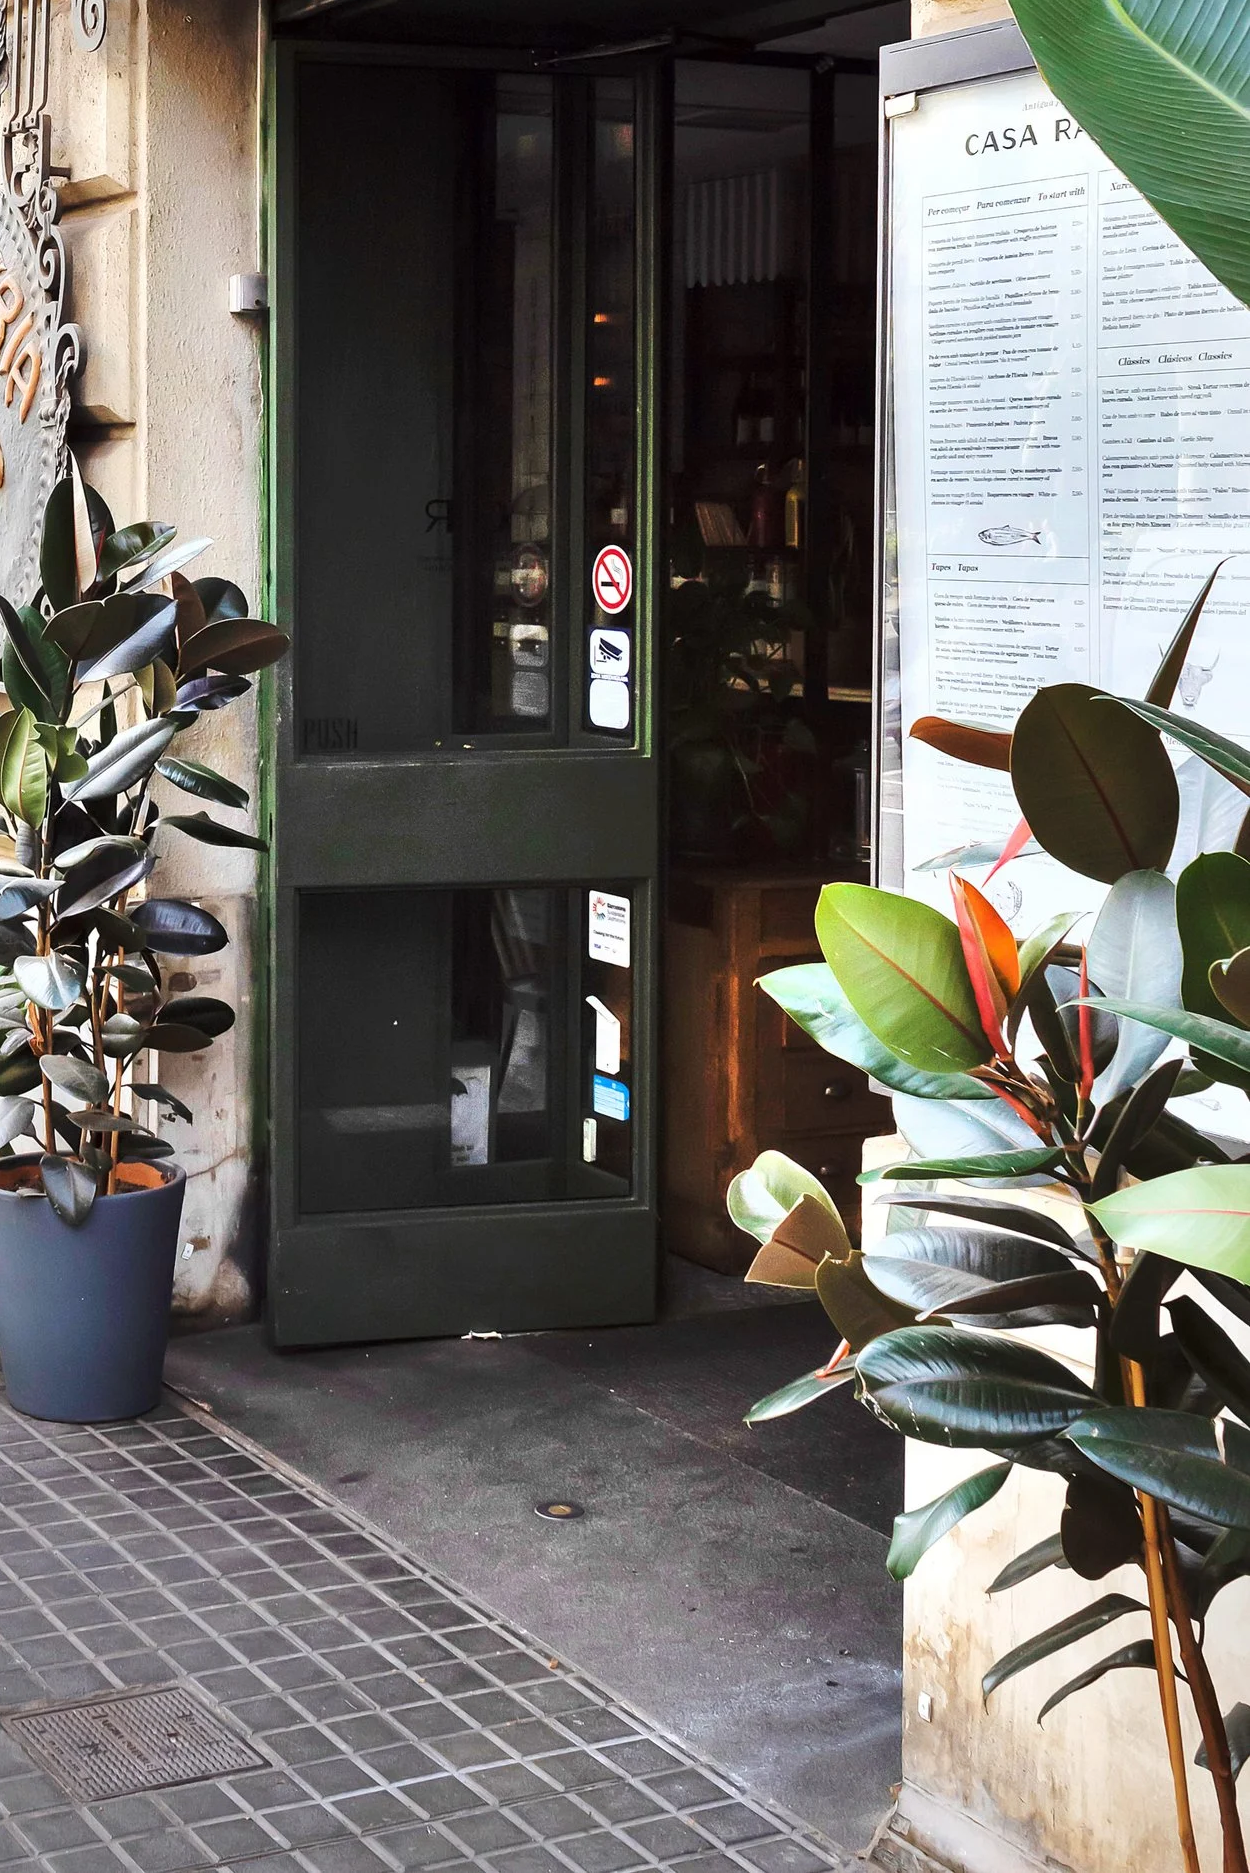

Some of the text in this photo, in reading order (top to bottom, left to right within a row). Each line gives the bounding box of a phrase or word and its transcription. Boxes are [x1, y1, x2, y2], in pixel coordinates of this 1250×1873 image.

[965, 124, 1038, 156] CASA
[1038, 192, 1048, 203] To
[1068, 186, 1086, 199] with
[1198, 351, 1233, 364] Classics
[931, 562, 979, 575] Tapes Tapas
